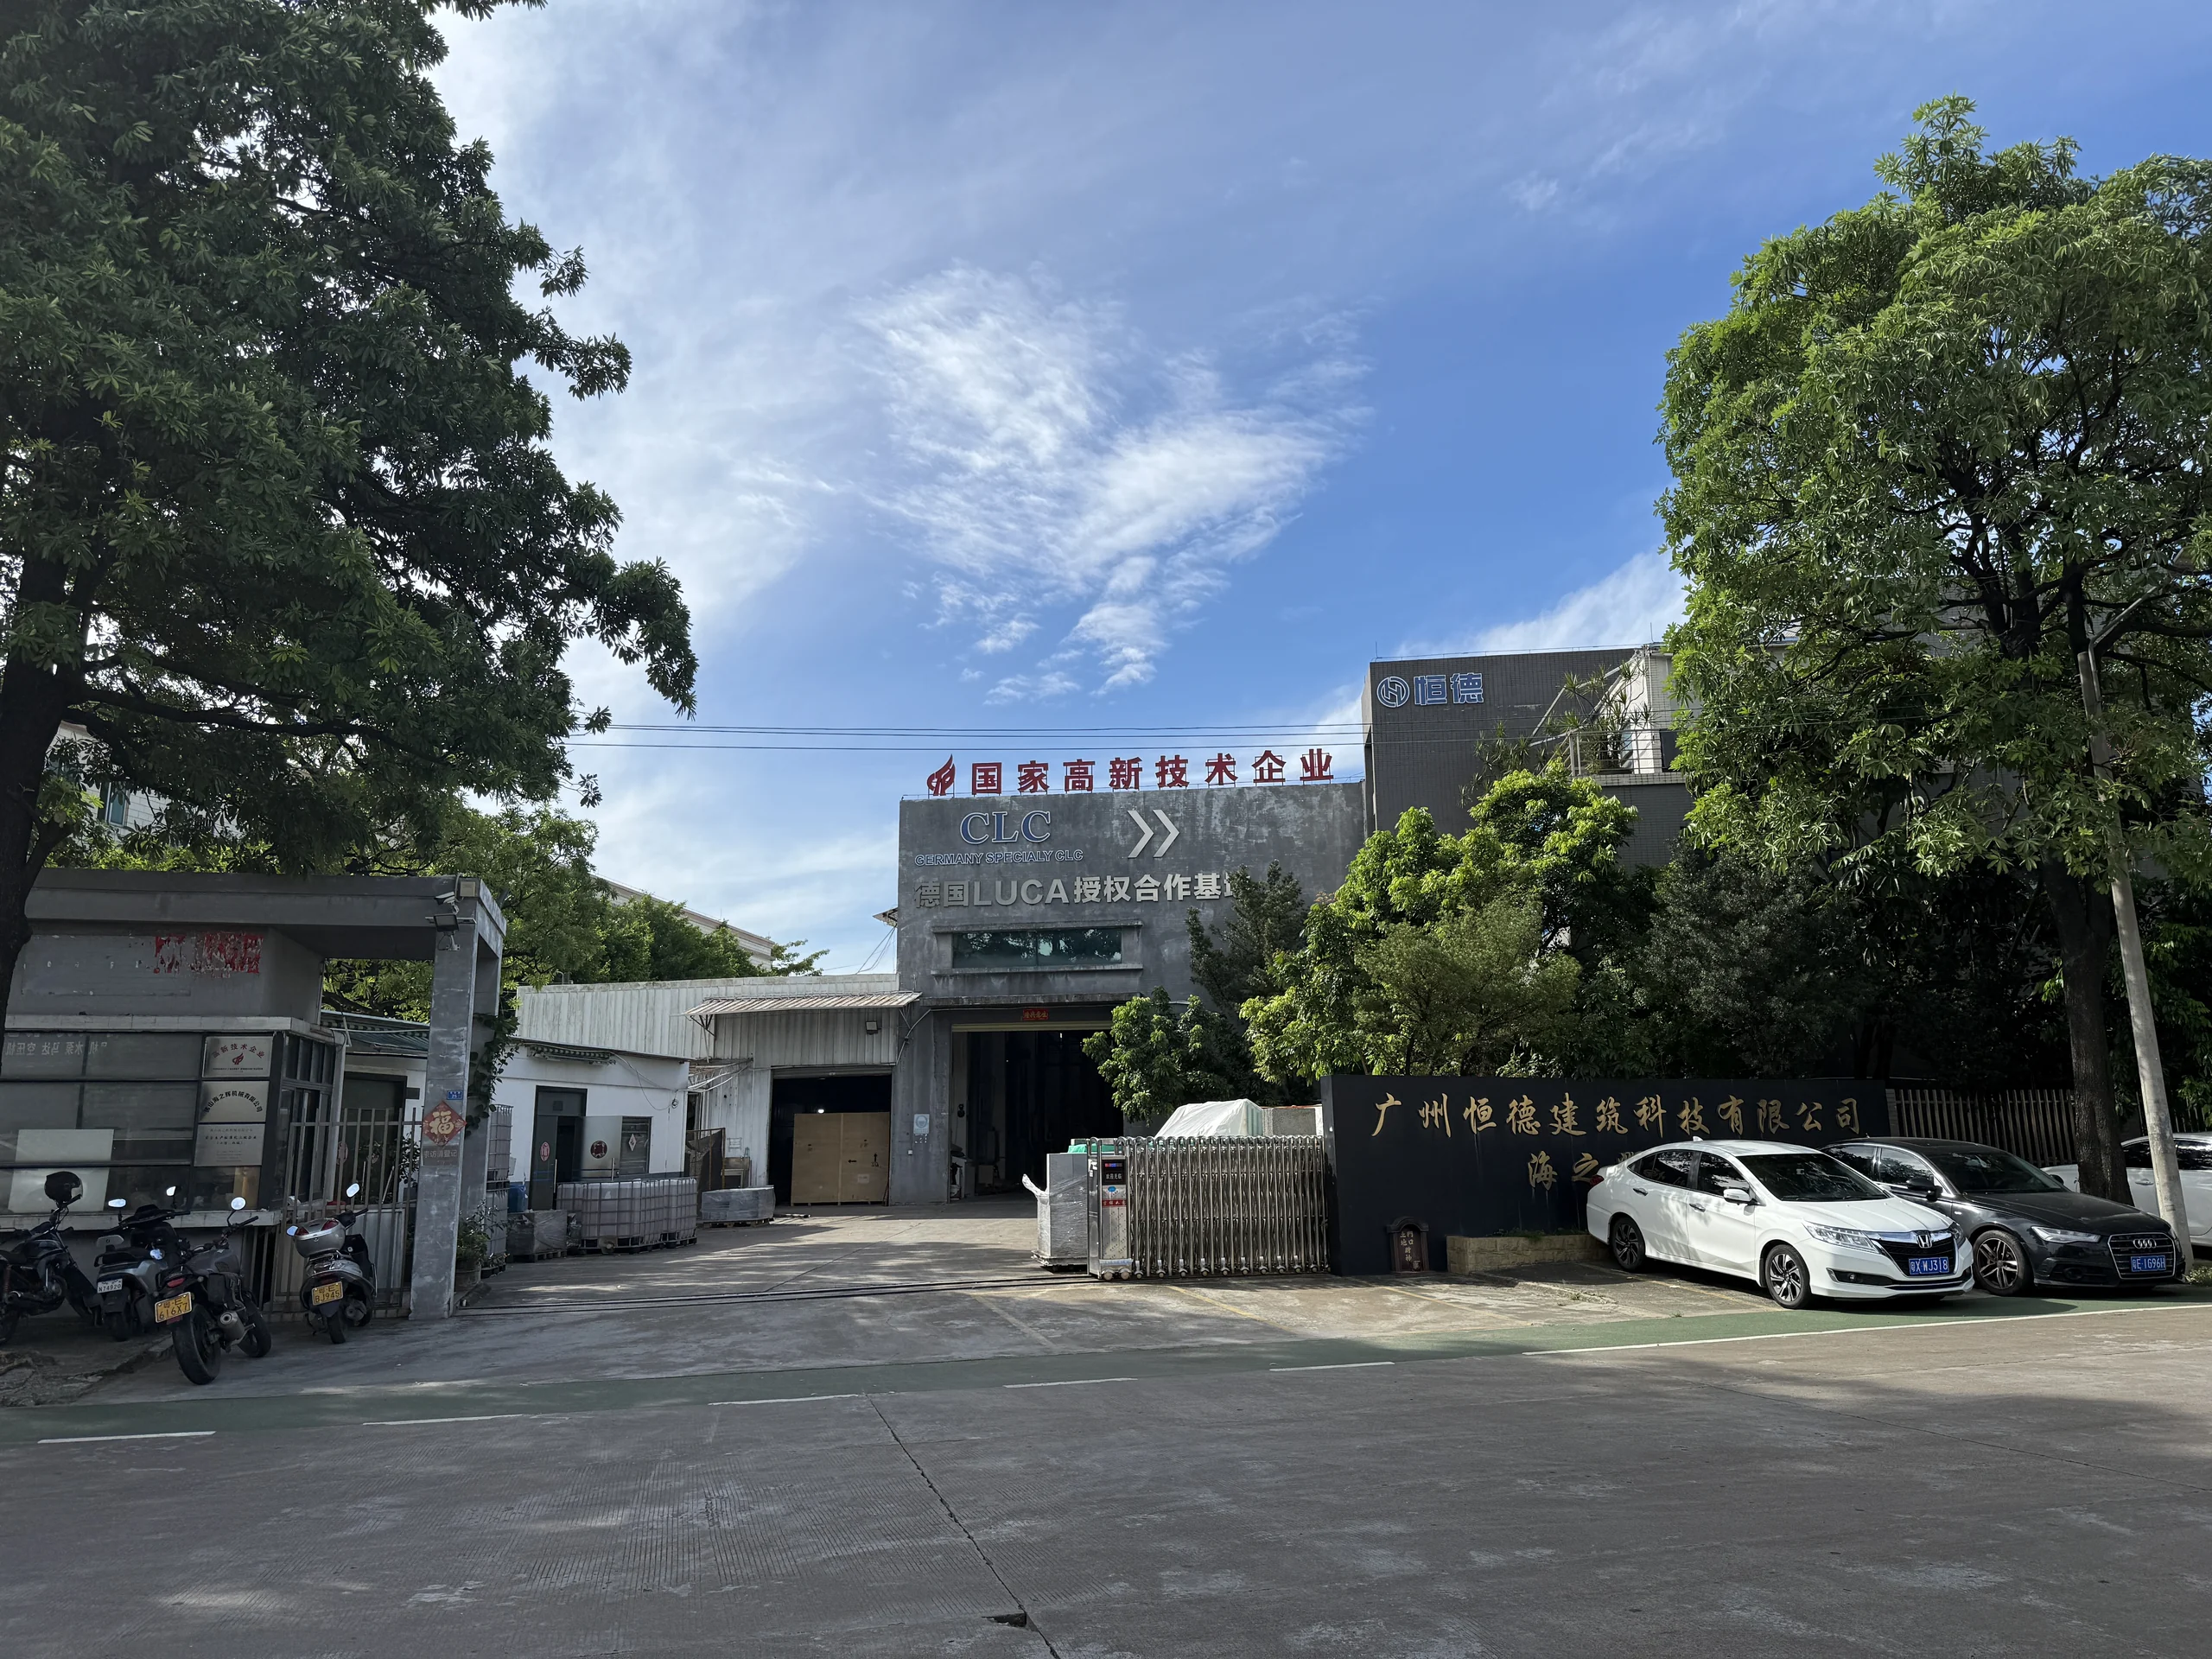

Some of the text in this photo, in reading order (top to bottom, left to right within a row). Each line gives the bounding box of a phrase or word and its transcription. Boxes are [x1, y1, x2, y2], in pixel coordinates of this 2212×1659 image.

[1414, 672, 1484, 705] 恒德
[972, 748, 1333, 795] 国家高新技术企业
[960, 810, 1051, 844] CLC
[915, 849, 1084, 866] GERMANY SPECIALY CLC
[212, 1043, 264, 1058] 高新技术企业
[429, 1110, 454, 1135] 福
[1371, 1092, 1859, 1139] 广州恒德建筑科技有限公司
[1529, 1150, 1640, 1191] 海之
[159, 1302, 188, 1319] 616X7
